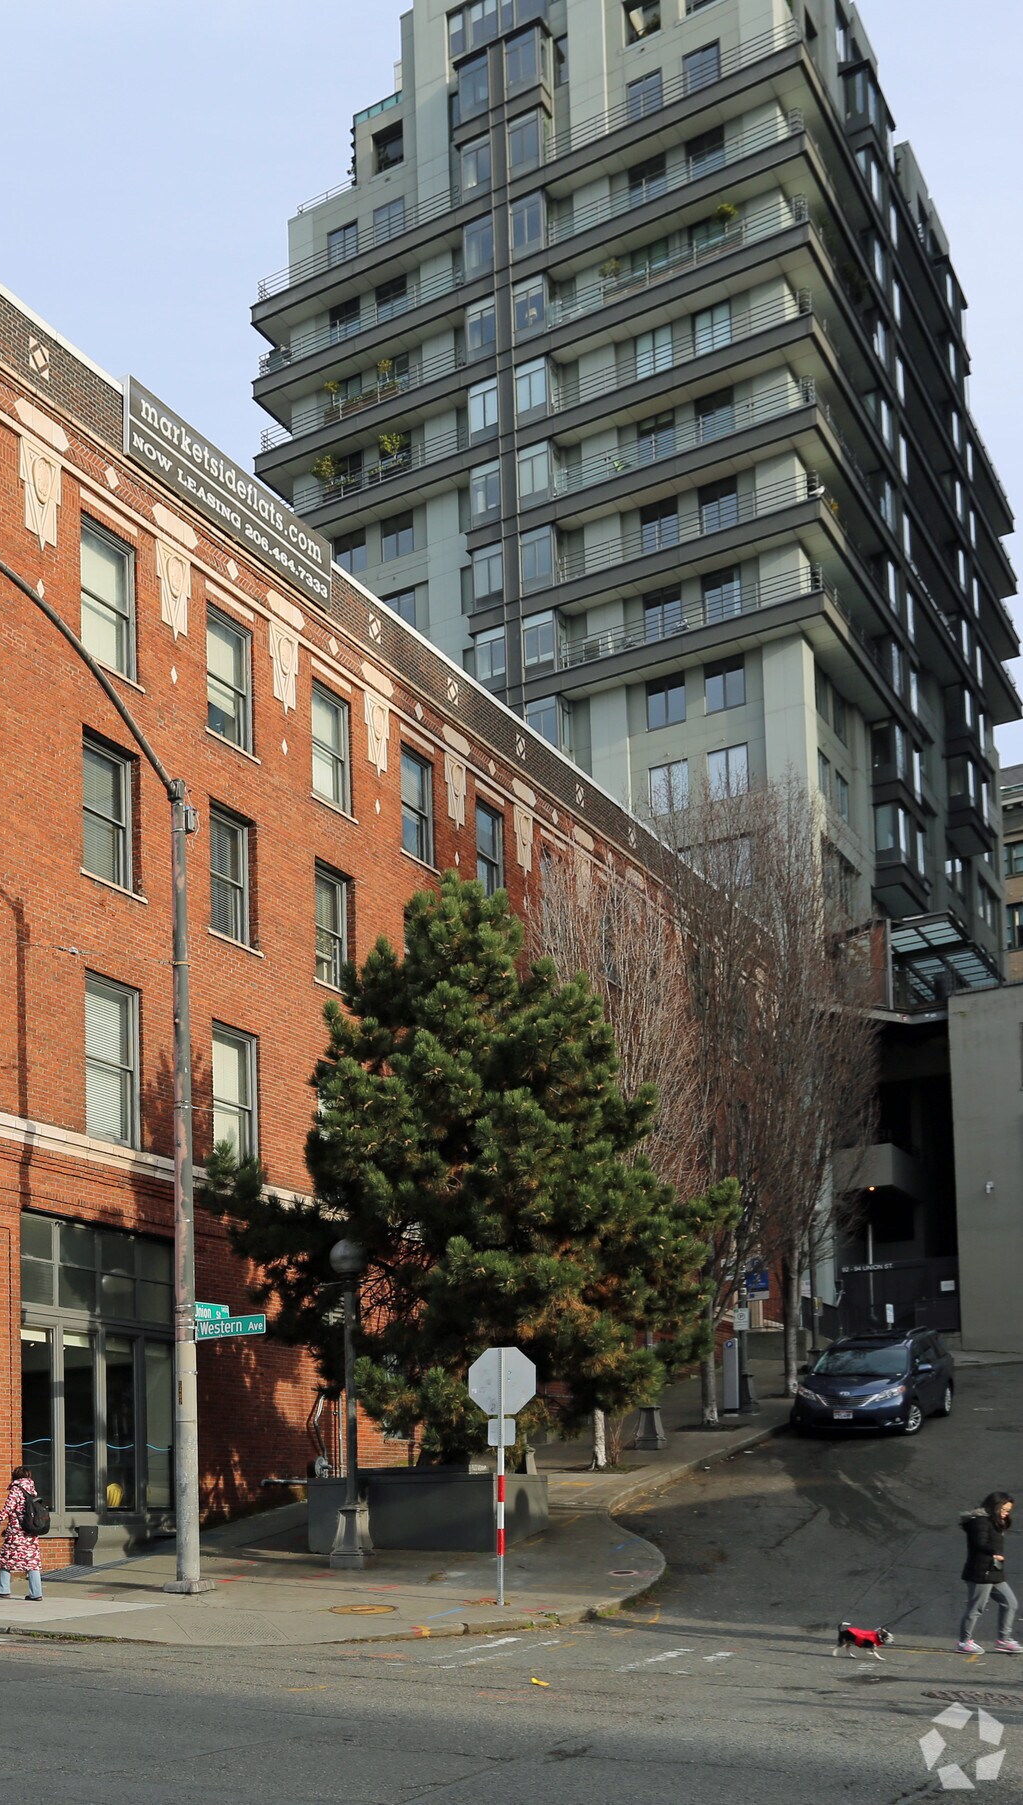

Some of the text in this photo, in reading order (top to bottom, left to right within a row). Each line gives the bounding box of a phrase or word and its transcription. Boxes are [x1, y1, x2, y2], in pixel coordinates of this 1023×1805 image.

[132, 432, 328, 599] NOW LEASING 206.464.7333
[140, 398, 323, 564] marketsideflats.com
[199, 1320, 263, 1336] Western Ave
